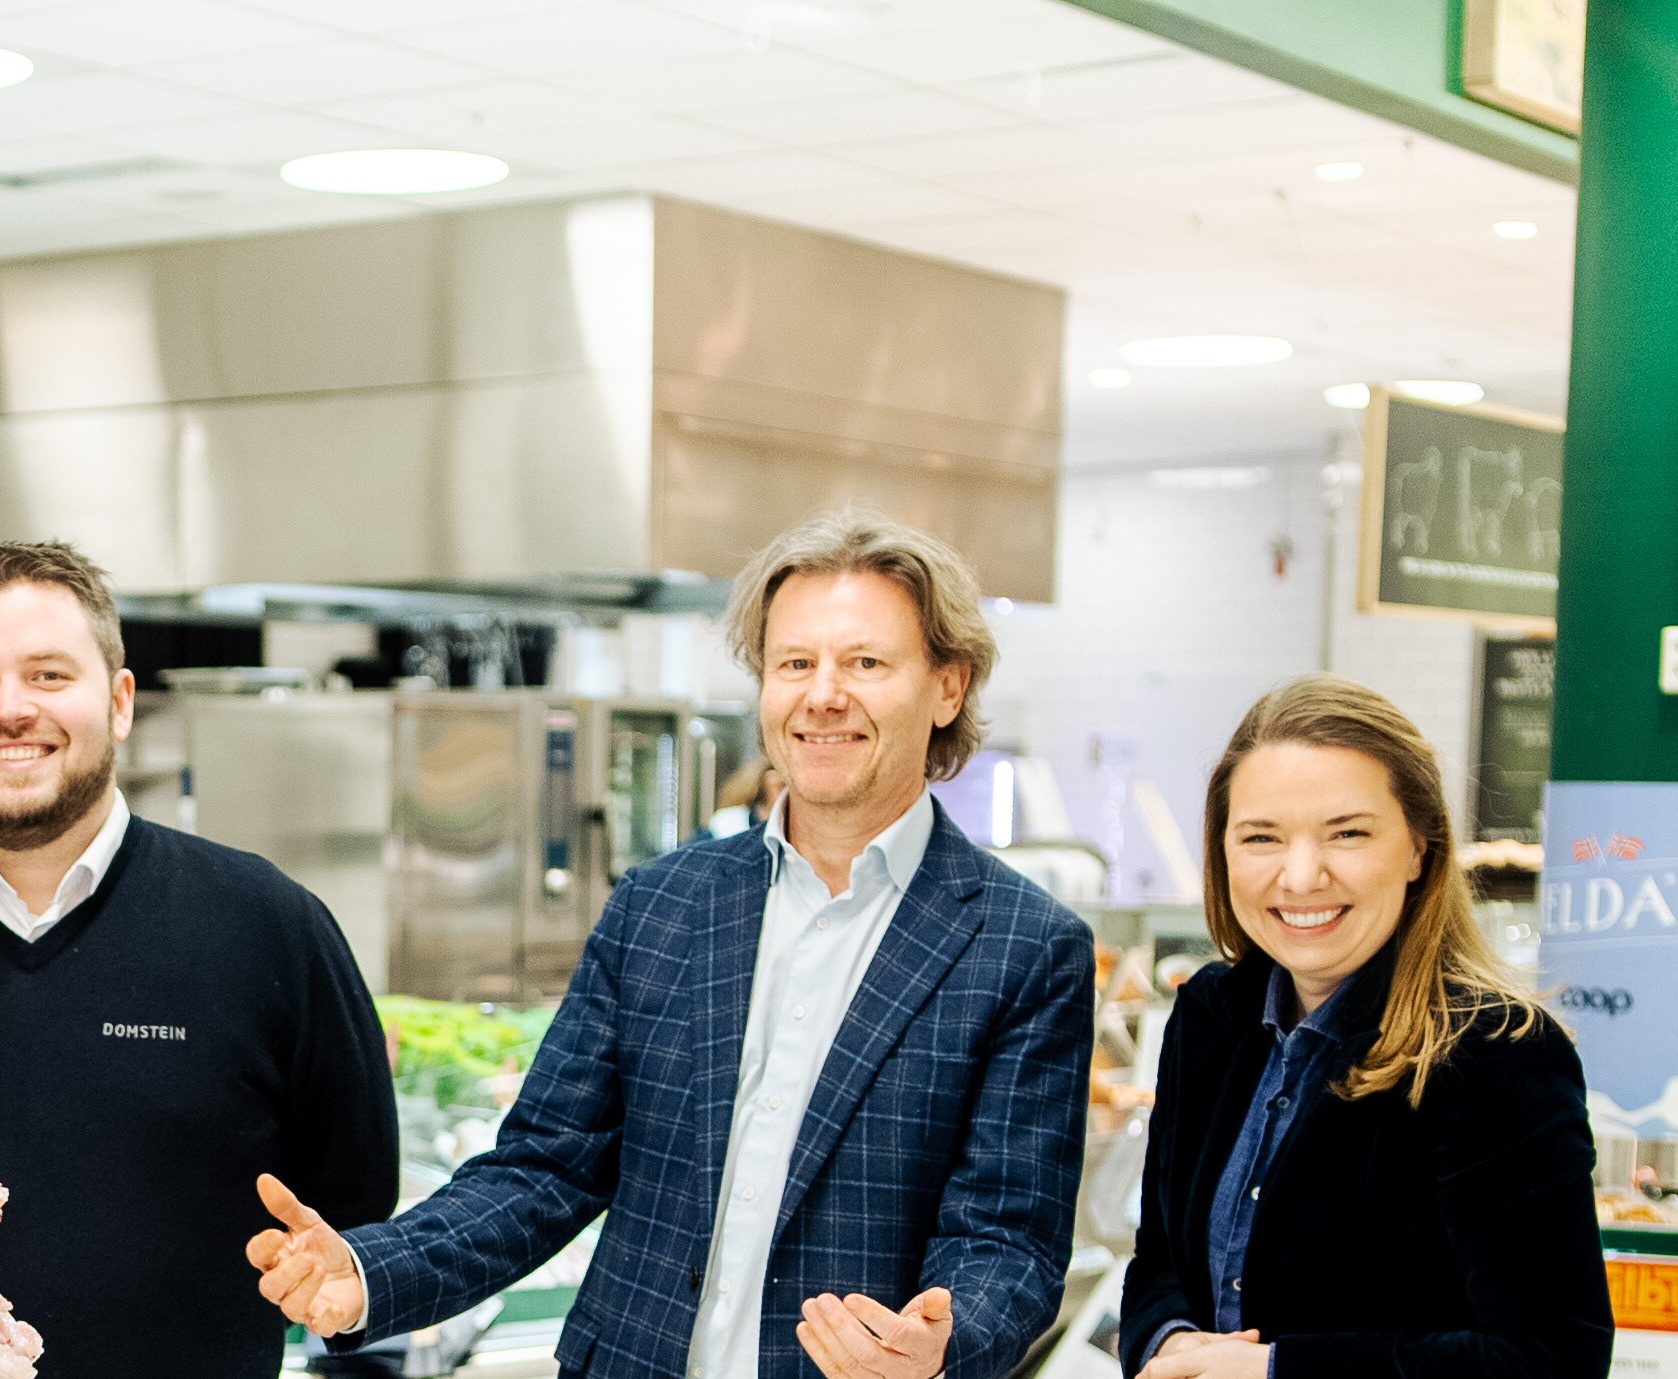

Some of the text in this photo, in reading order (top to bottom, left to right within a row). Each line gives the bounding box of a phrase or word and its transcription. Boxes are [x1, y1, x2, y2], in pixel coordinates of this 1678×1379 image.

[1540, 873, 1678, 932] ELDA
[1560, 985, 1634, 1020] coop
[102, 1022, 186, 1041] DOMSTEIN
